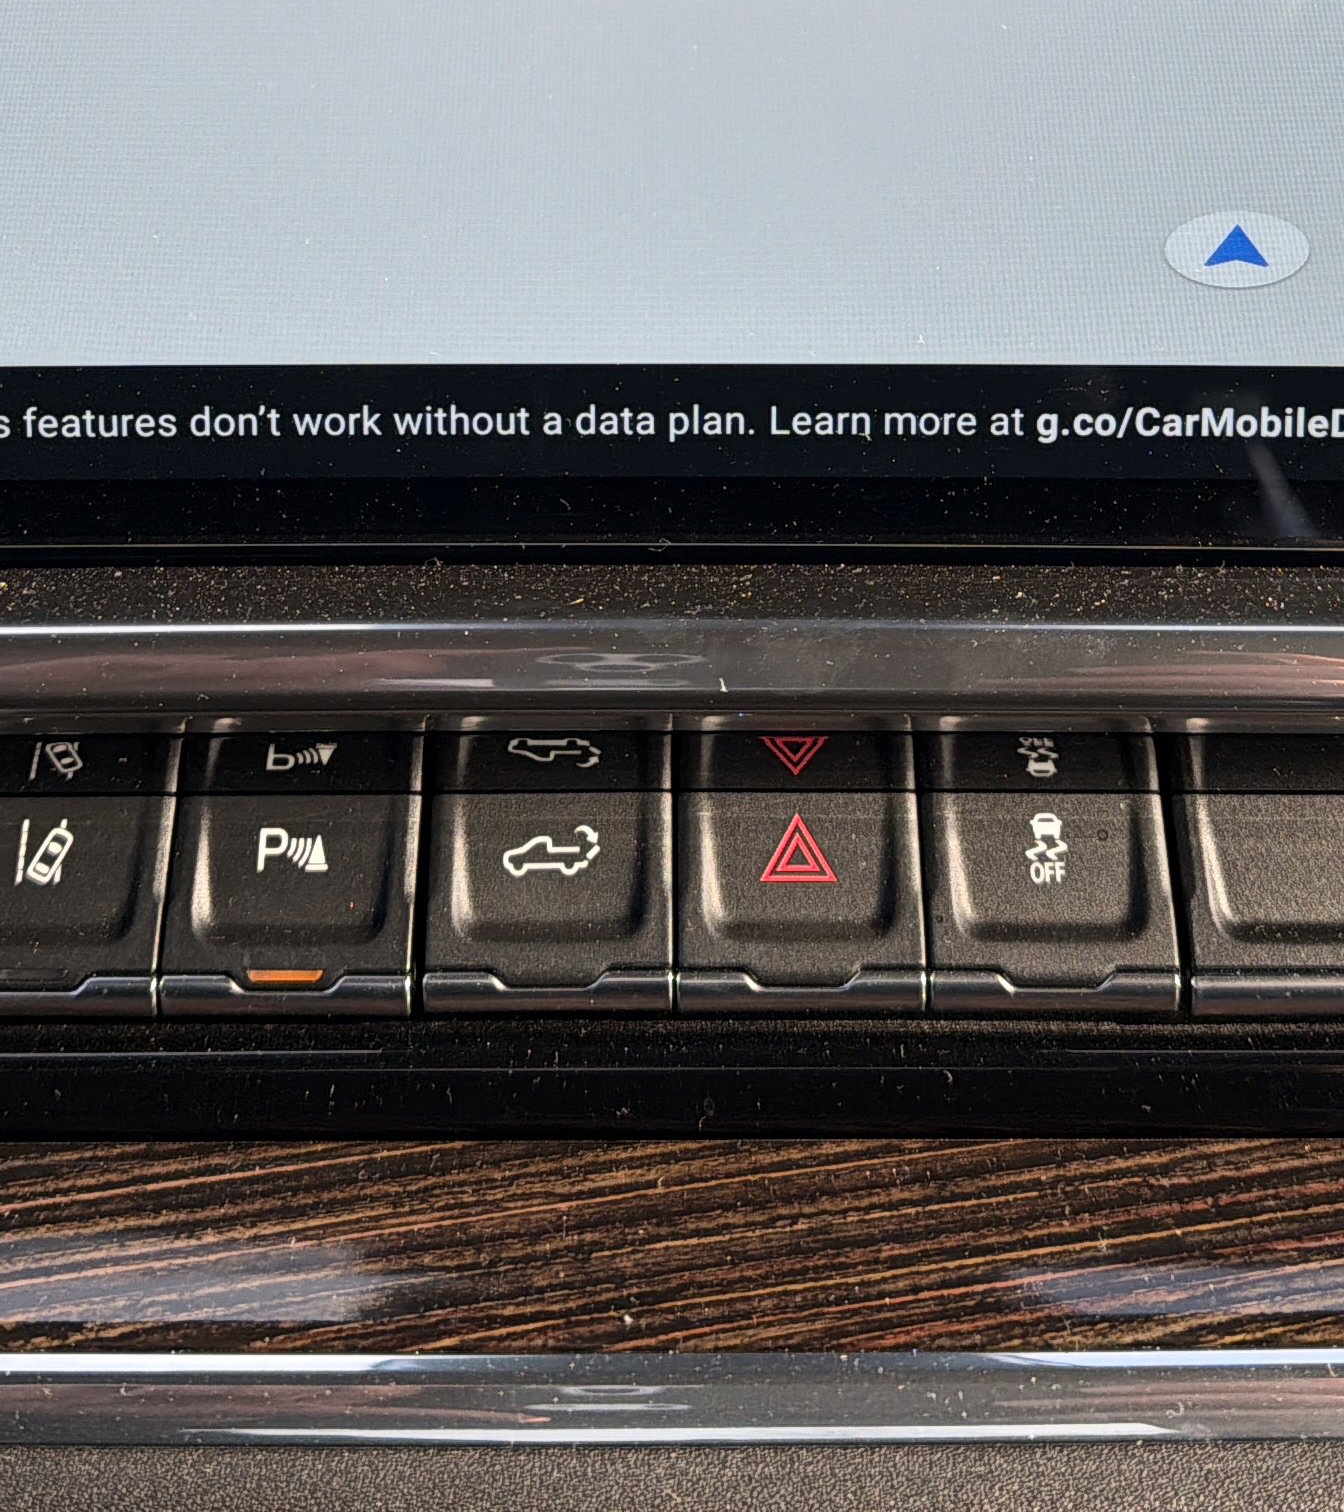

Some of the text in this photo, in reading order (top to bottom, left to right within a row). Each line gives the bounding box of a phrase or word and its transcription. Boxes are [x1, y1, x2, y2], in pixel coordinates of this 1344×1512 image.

[22, 405, 178, 439] features
[291, 404, 384, 437] work
[393, 403, 532, 437] without
[542, 412, 563, 437] a
[574, 402, 657, 437] data
[668, 402, 756, 444] plan.
[769, 404, 872, 439] Learn
[883, 411, 978, 437] more
[989, 407, 1026, 437] at
[1029, 861, 1067, 884] OFF
